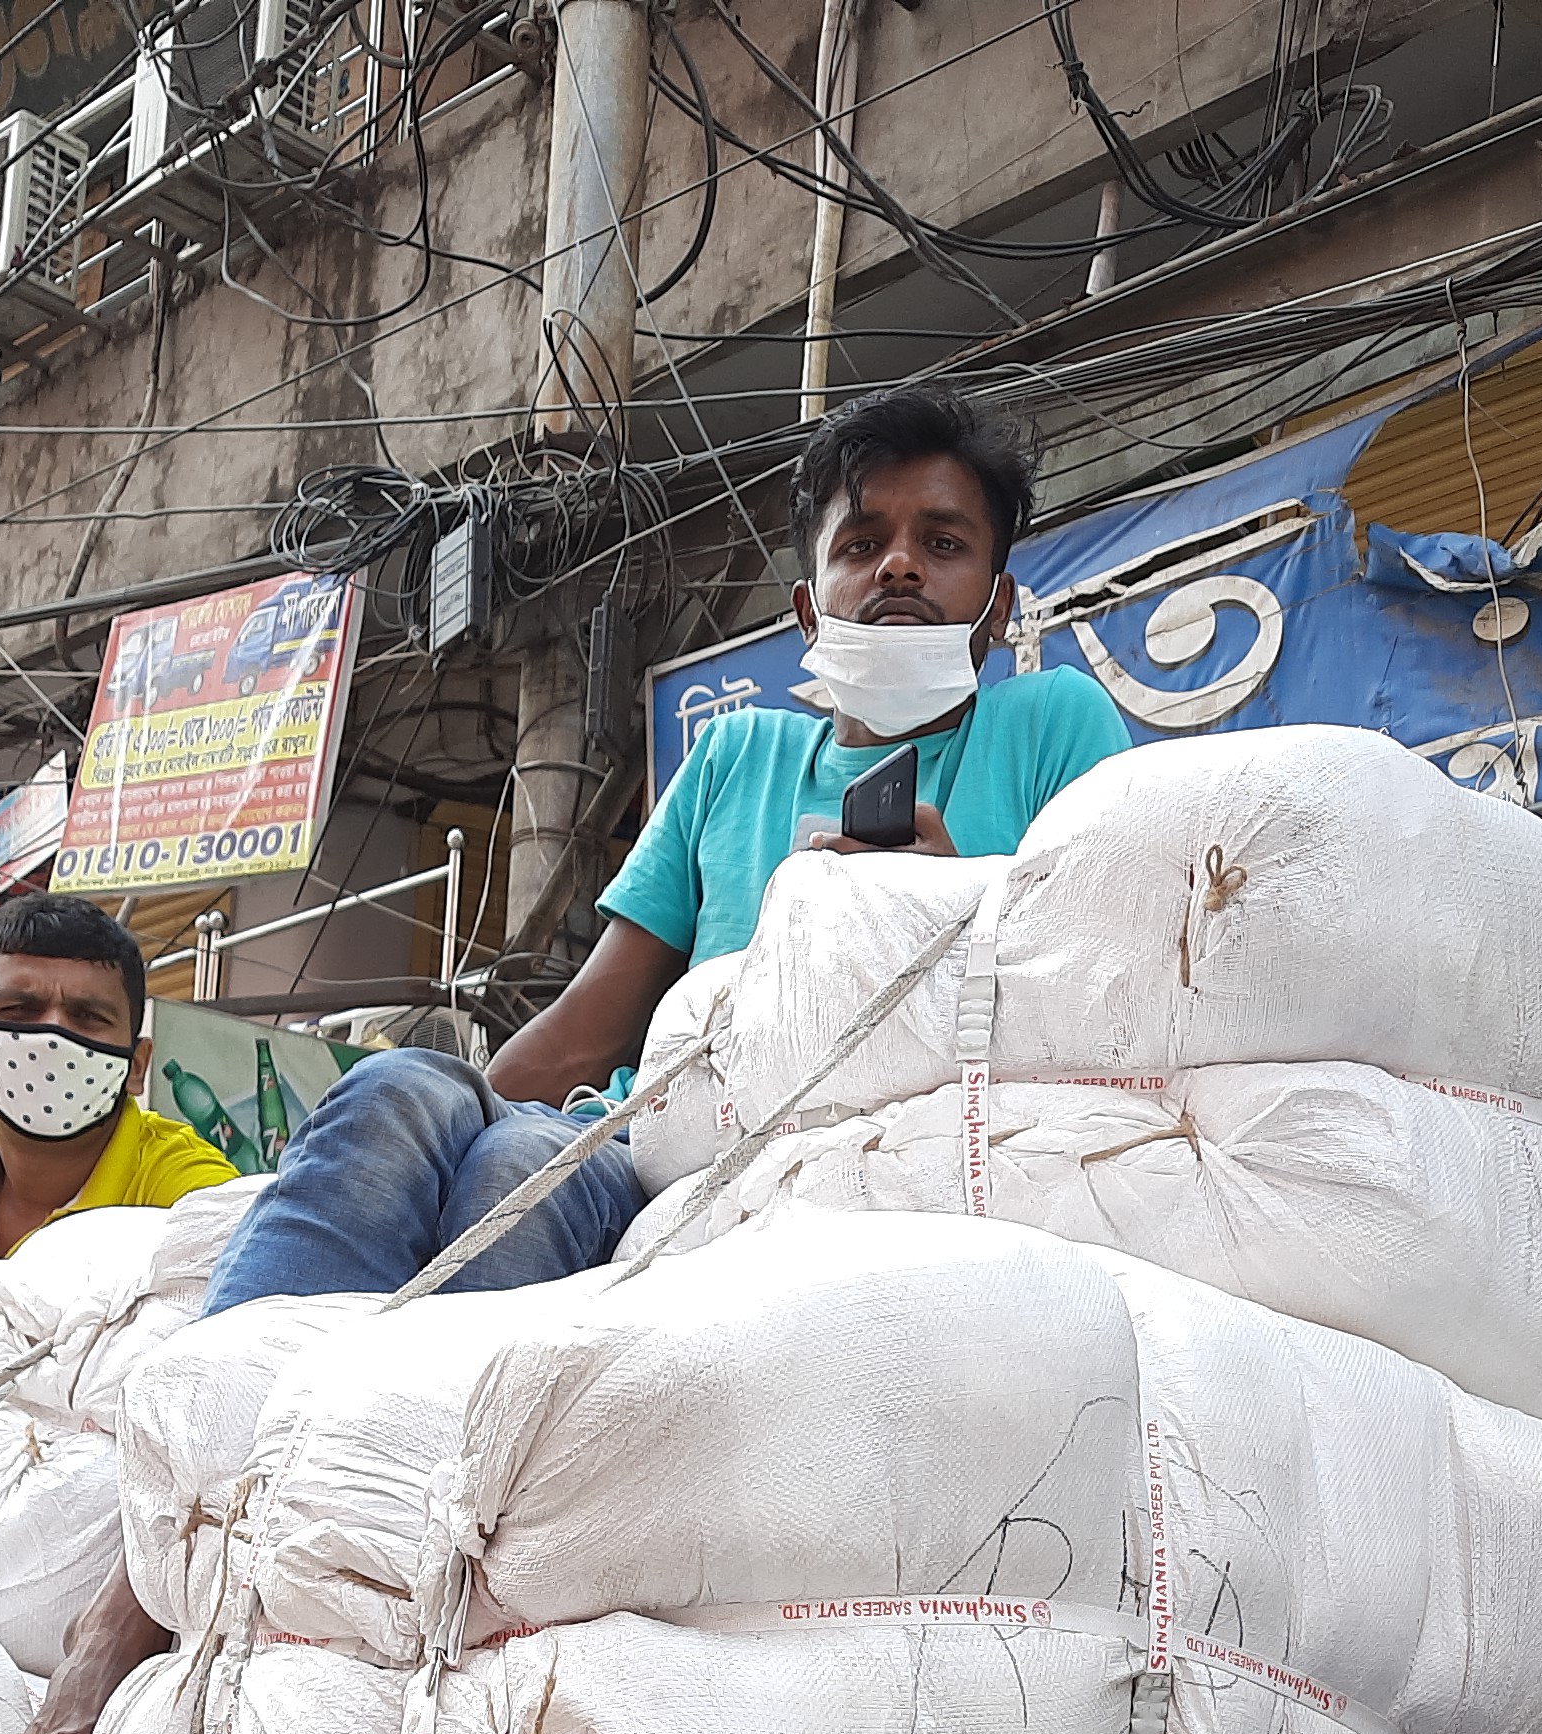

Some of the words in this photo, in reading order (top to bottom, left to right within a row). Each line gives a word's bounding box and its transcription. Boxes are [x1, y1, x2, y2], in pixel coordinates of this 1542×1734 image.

[56, 822, 303, 879] 01810-130001
[1152, 1484, 1167, 1541] SAREES
[852, 1599, 913, 1618] SAREES
